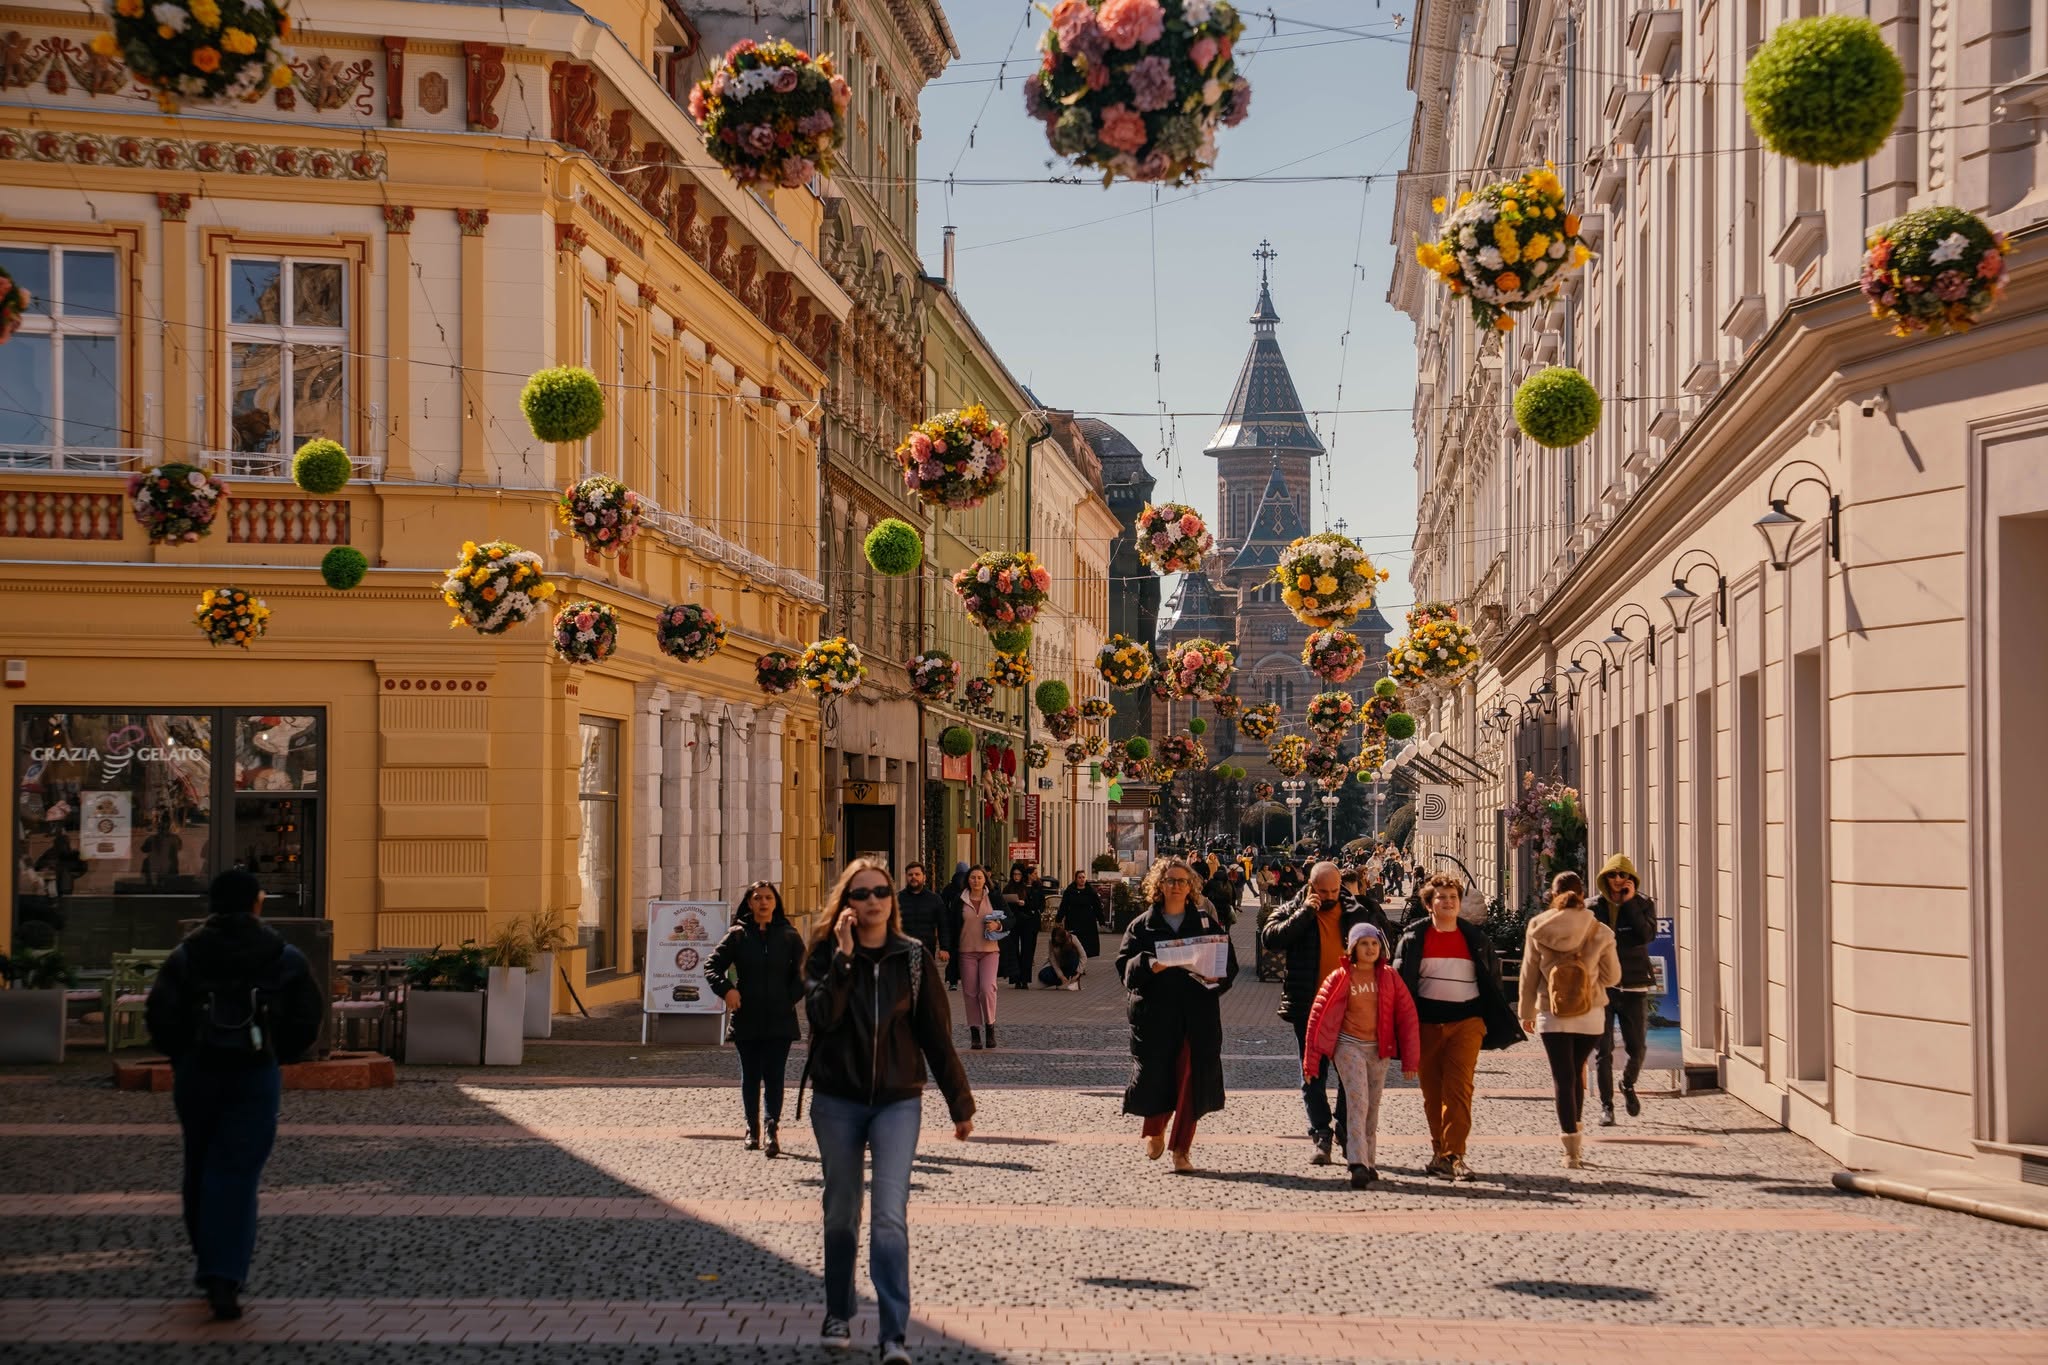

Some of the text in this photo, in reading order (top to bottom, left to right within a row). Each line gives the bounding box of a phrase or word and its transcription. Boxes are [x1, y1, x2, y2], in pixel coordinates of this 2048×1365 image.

[31, 747, 203, 762] GRAZIA GELATO
[1027, 796, 1037, 838] EXCHANGE
[1656, 919, 1671, 933] R
